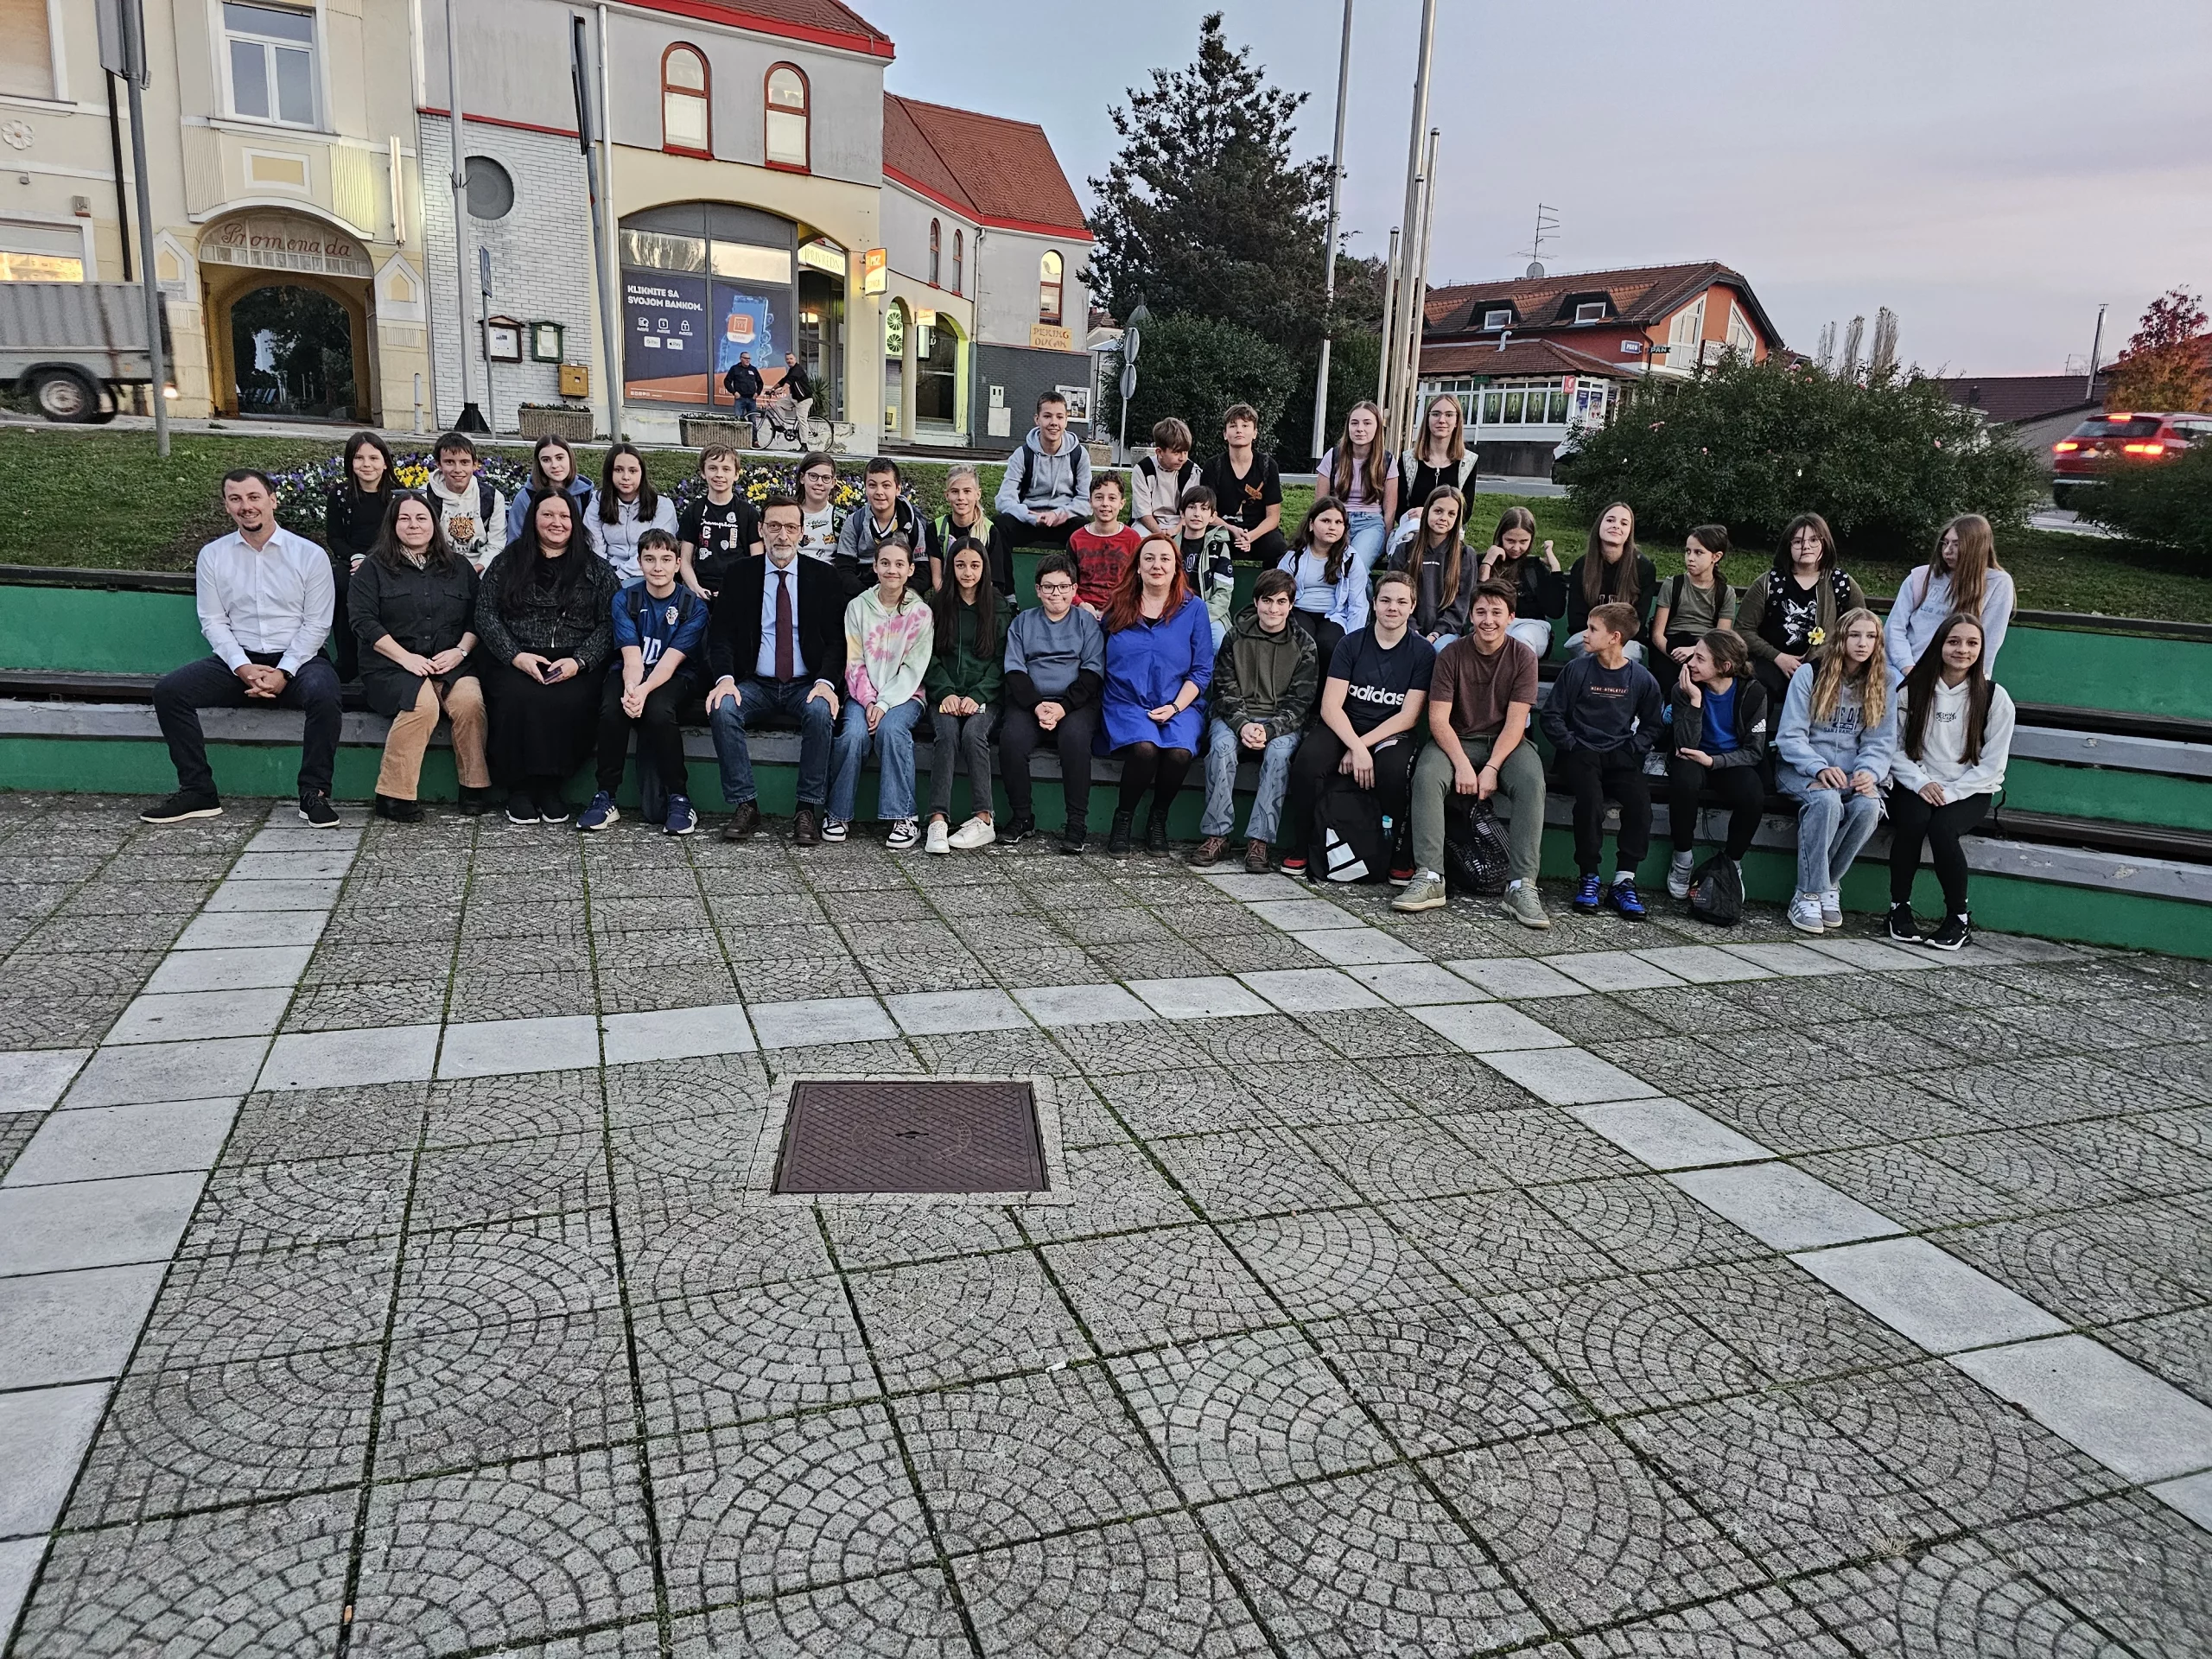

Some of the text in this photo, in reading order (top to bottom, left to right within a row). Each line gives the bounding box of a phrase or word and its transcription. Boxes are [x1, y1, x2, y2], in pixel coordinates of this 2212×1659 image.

[220, 223, 352, 257] Promenada
[627, 284, 680, 299] KLIKNITE SA
[627, 296, 703, 311] SVOJOM BANKOM.
[1033, 327, 1069, 340] PEKING
[642, 636, 661, 664] 10
[1349, 684, 1405, 705] adidas
